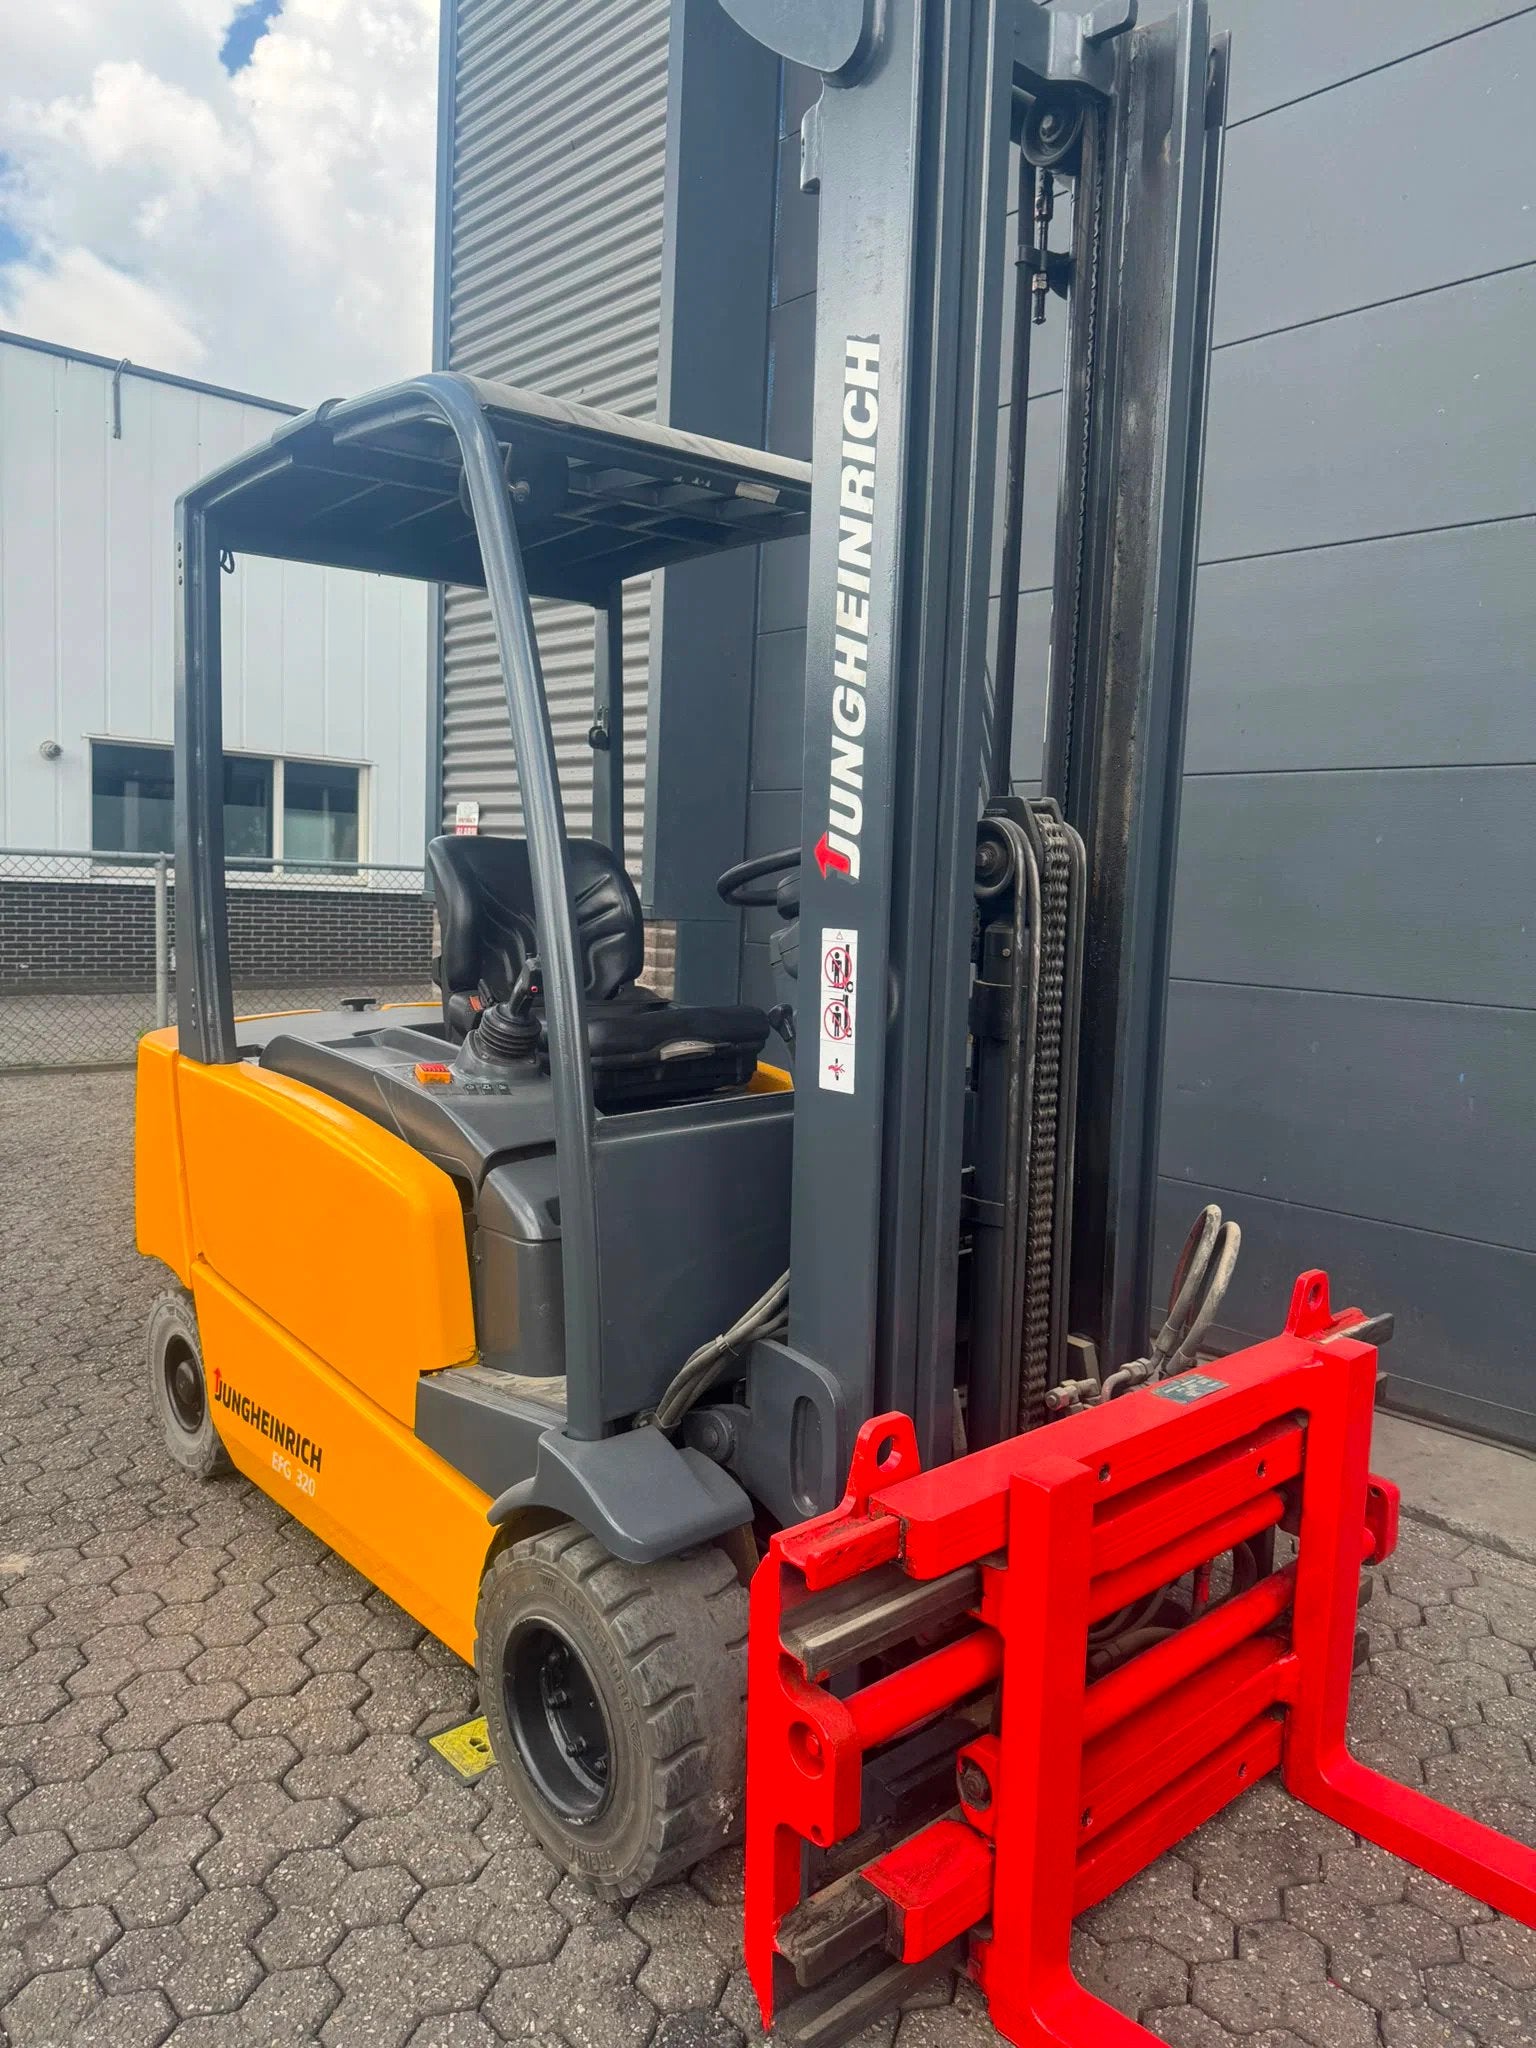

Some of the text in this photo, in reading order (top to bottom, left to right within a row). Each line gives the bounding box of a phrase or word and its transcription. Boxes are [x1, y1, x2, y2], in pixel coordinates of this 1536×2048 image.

[823, 339, 880, 880] JUNGHEINRICH
[214, 1380, 323, 1474] JUNGHEINRICH
[271, 1451, 316, 1498] EFG 320
